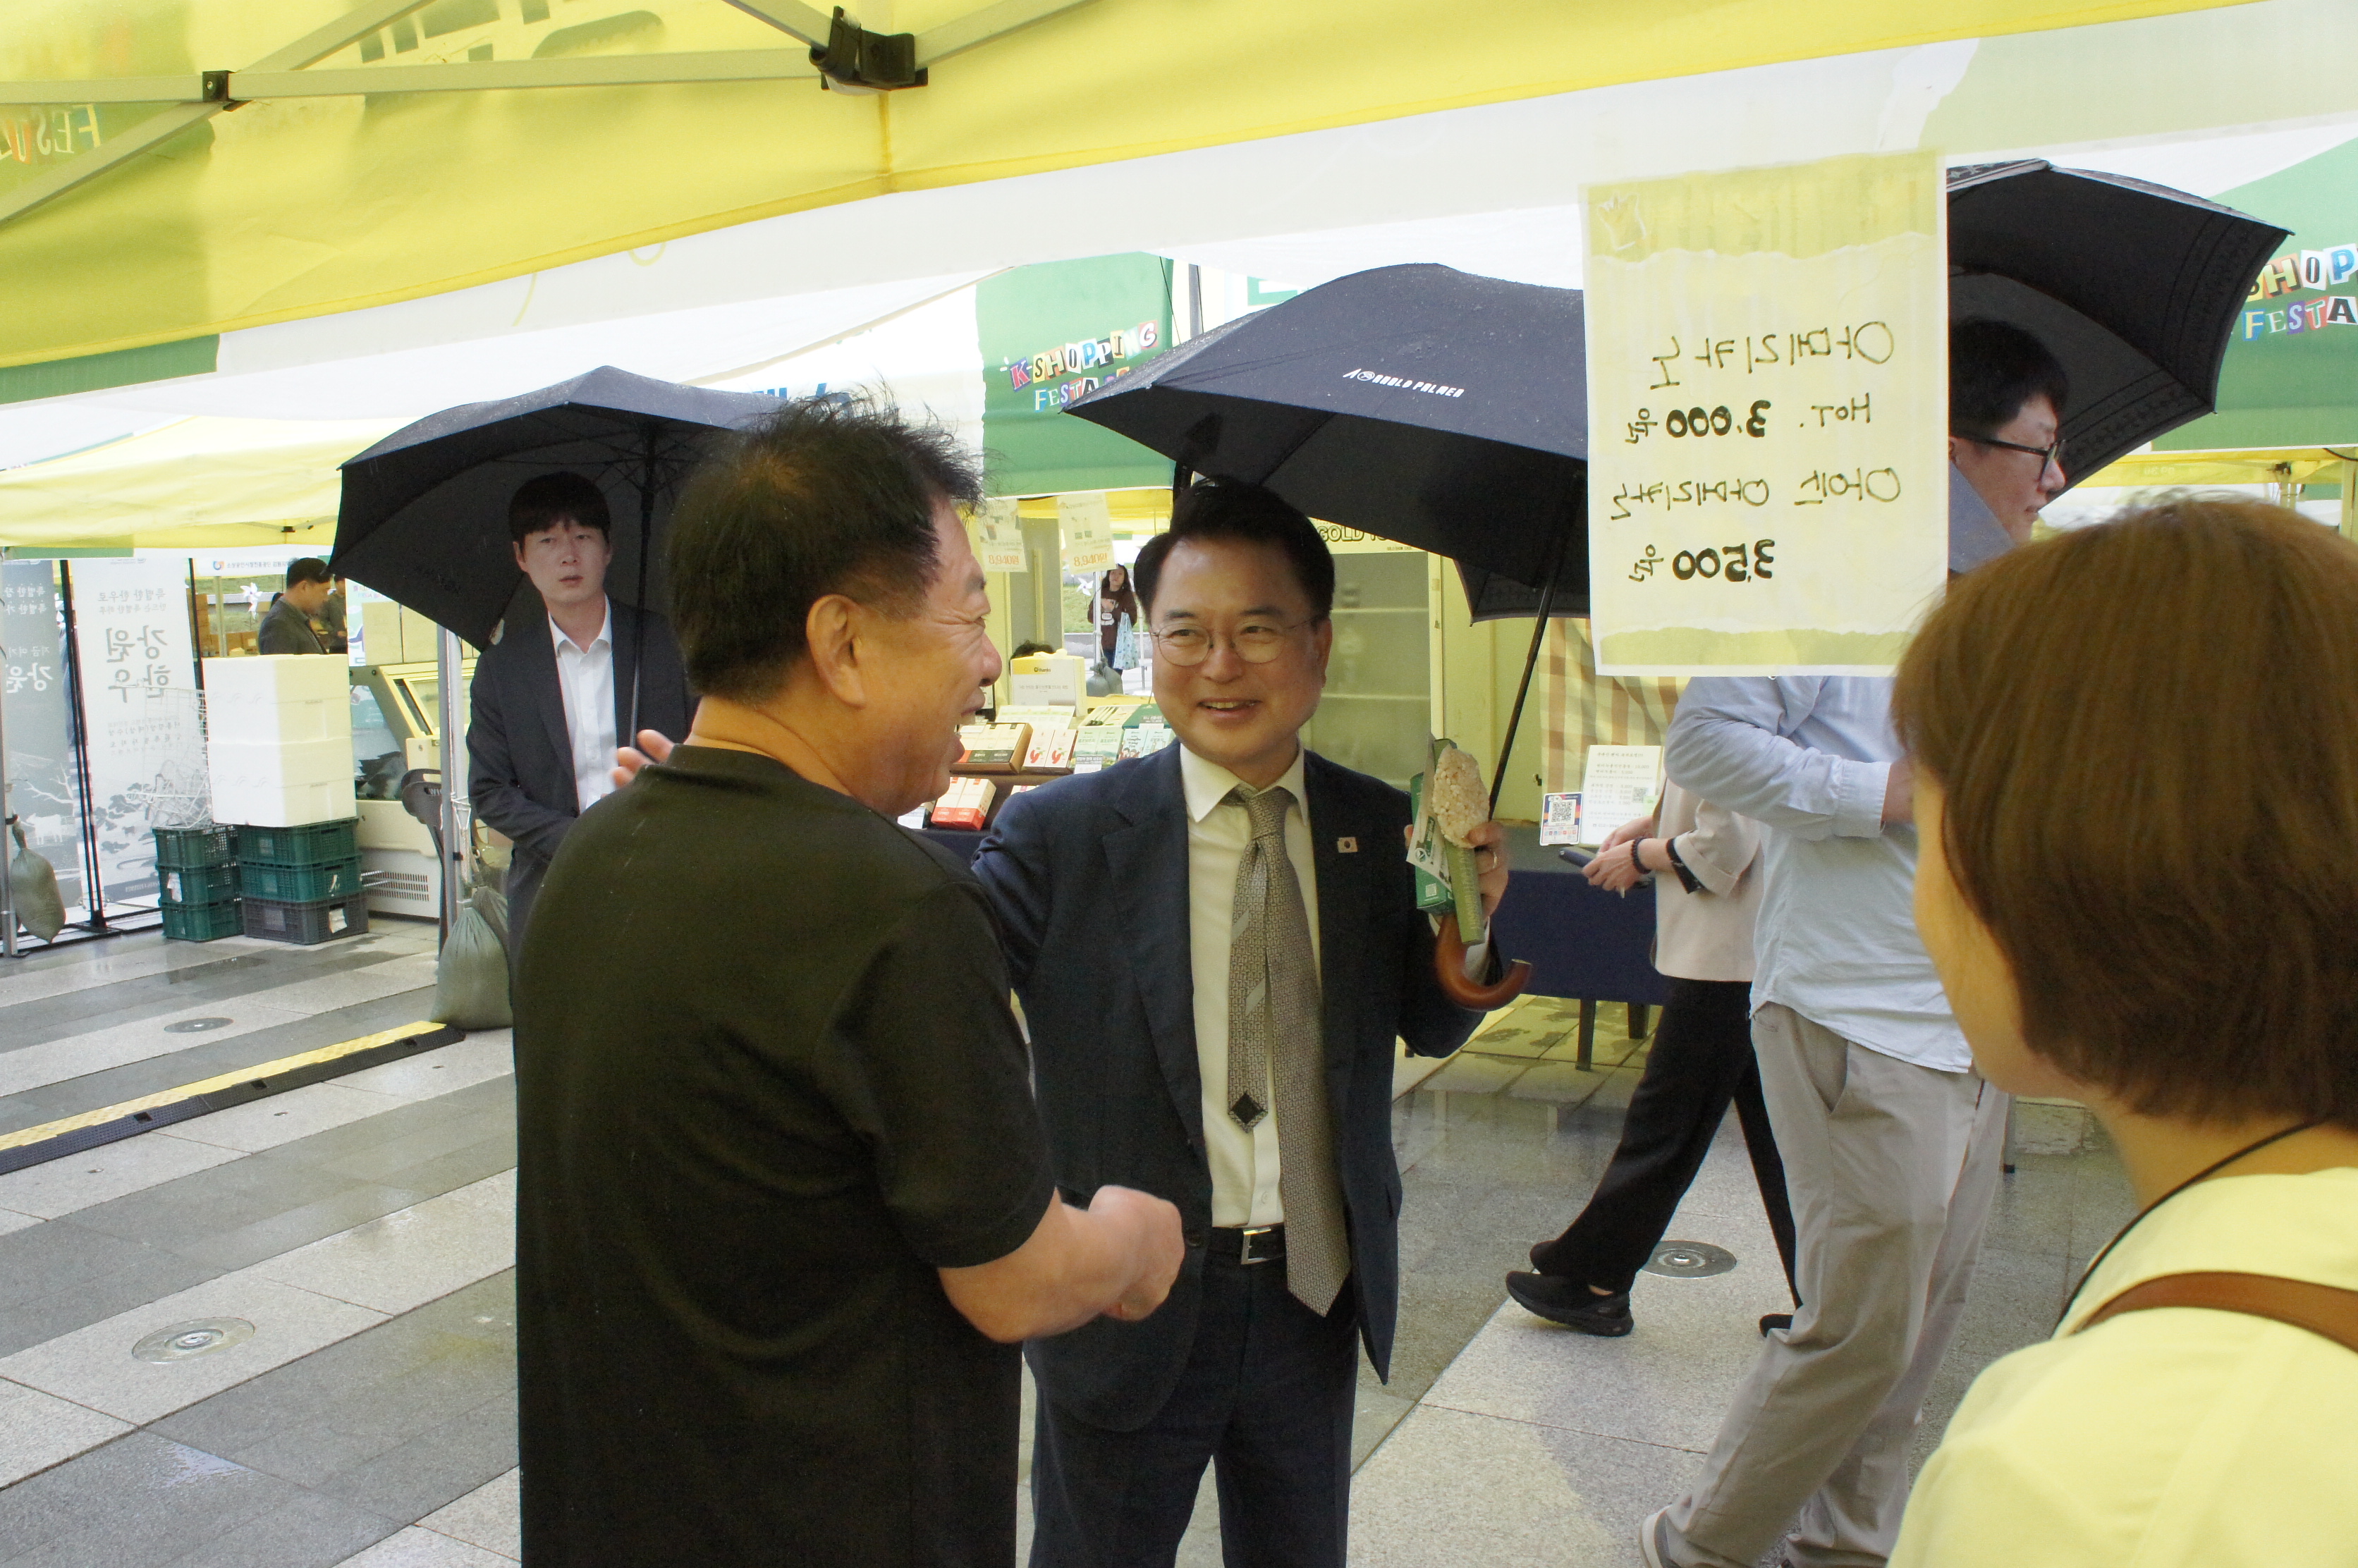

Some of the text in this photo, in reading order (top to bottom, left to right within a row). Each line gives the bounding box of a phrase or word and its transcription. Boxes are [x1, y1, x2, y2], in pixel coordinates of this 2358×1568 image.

[2245, 298, 2357, 339] FESTA
[1010, 321, 1158, 391] K-SHOPPING
[1412, 381, 1465, 398] PALMER
[1317, 525, 1364, 542] GOLD
